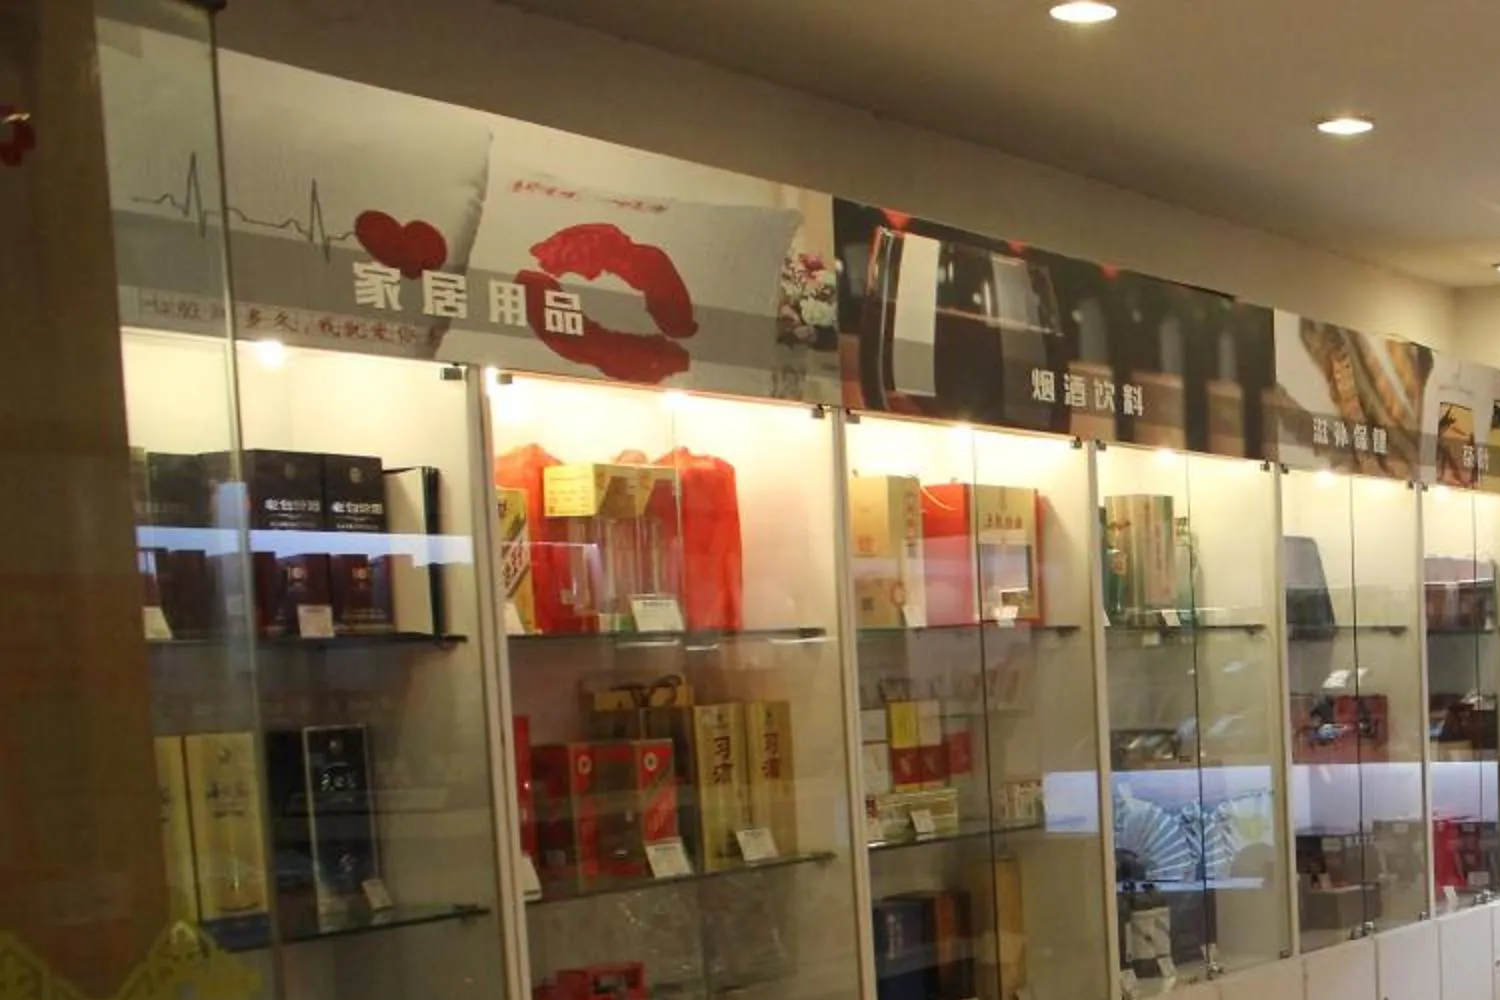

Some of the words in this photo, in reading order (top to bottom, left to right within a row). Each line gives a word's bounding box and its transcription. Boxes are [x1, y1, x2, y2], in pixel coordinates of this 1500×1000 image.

[352, 261, 584, 336] 家居用品
[1031, 367, 1144, 416] 烟酒饮料
[1313, 417, 1388, 454] 滋补保健
